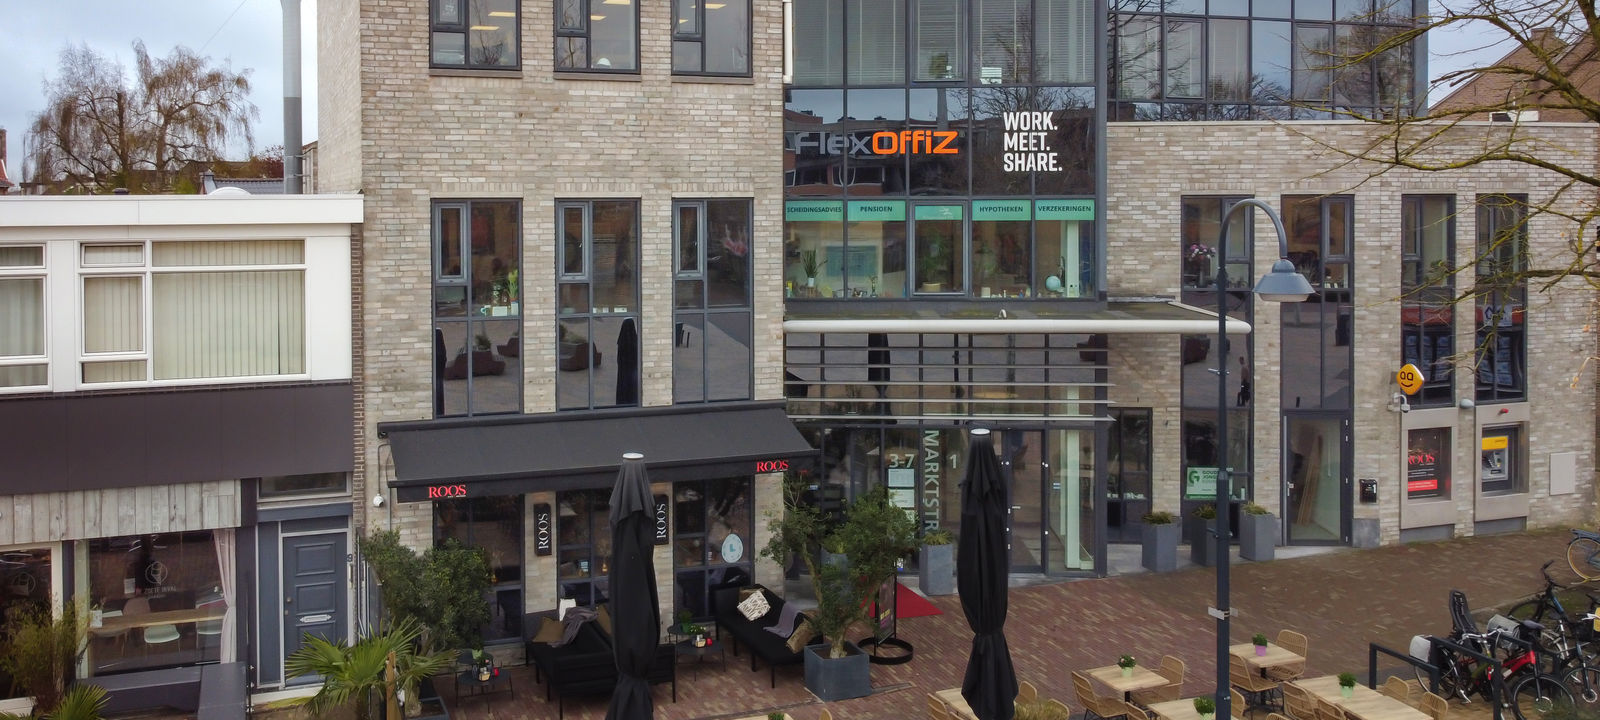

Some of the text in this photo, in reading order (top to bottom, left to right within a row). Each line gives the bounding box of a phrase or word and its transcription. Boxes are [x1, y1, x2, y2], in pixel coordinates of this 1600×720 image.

[1003, 111, 1058, 131] WORK.
[1003, 131, 1050, 151] MEET.
[1003, 152, 1063, 172] SHARE.
[756, 460, 790, 473] ROOS
[889, 453, 915, 468] 3-7
[949, 454, 957, 469] 1
[428, 484, 467, 498] ROOS
[538, 512, 549, 550] ROOS
[656, 503, 667, 539] ROOS
